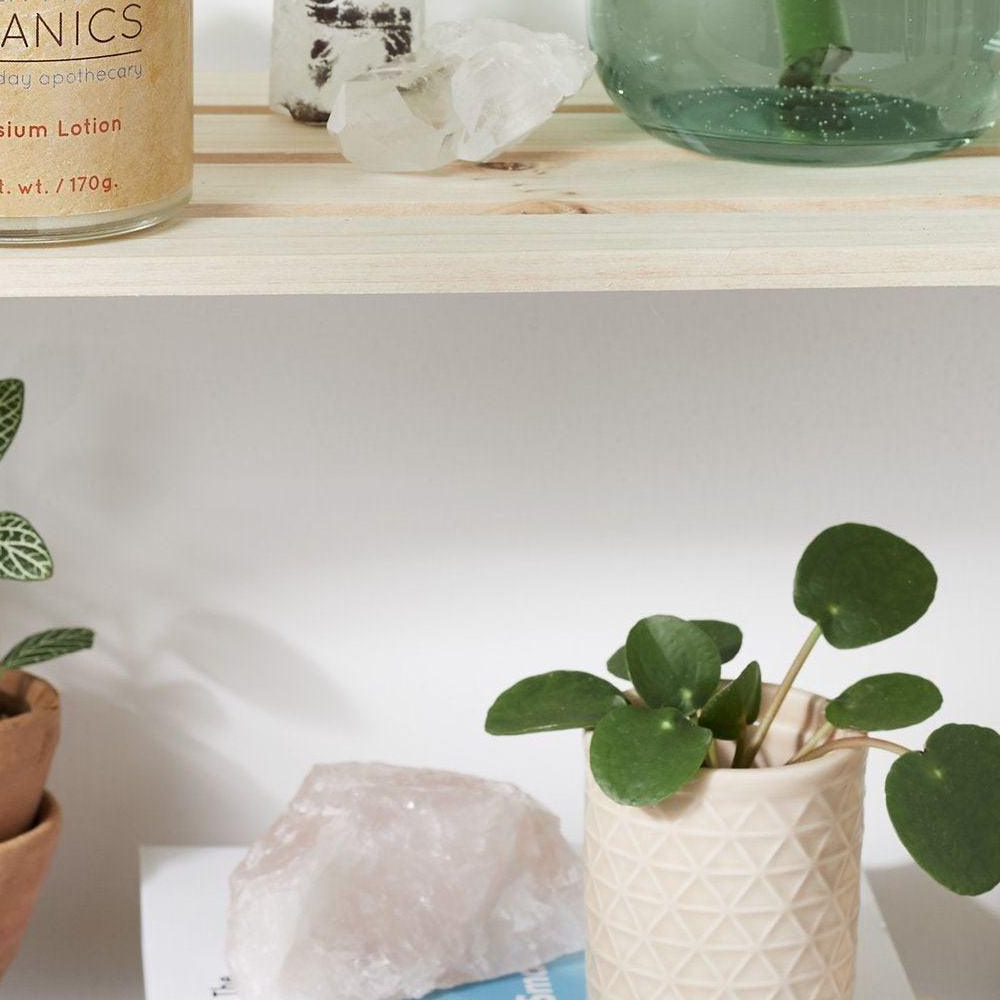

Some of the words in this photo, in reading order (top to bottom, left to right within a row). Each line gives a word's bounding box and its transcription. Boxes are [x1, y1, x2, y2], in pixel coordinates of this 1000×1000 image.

[39, 63, 143, 88] apothecary
[58, 117, 121, 137] Lotion
[19, 180, 47, 194] wt.
[56, 178, 63, 194] /
[70, 175, 118, 193] 170g.
